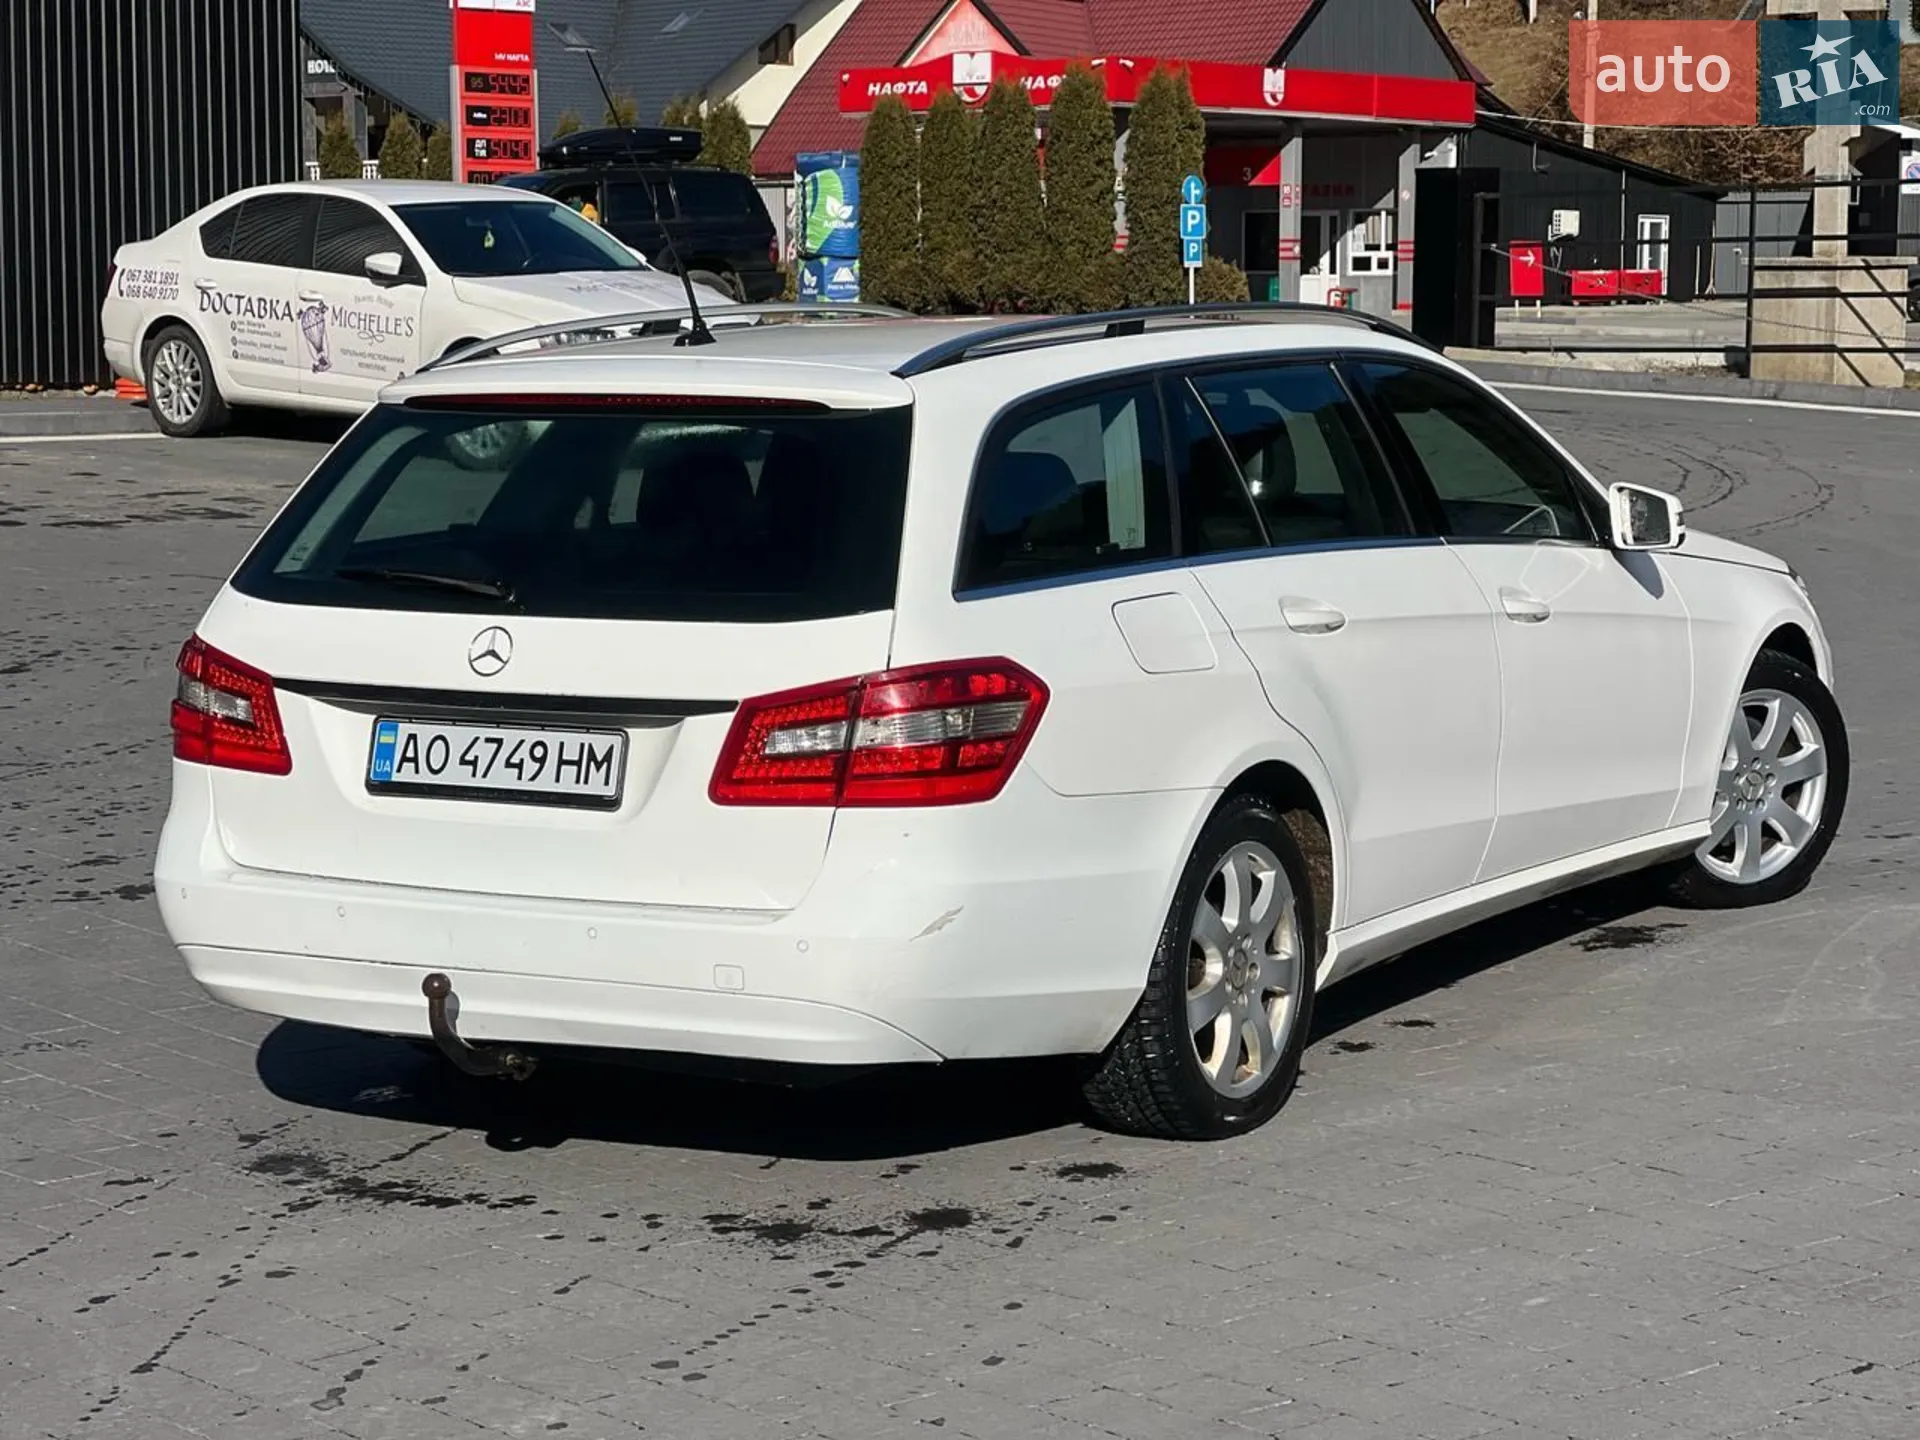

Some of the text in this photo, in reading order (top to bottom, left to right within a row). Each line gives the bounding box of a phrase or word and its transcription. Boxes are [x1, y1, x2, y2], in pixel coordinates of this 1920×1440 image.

[867, 80, 929, 97] НАФТА
[1020, 73, 1066, 91] НАФ
[1187, 209, 1201, 233] P
[1188, 242, 1199, 259] P
[142, 269, 158, 284] 381
[158, 270, 180, 286] 1891
[142, 285, 158, 300] 640
[157, 287, 180, 301] 9170
[375, 762, 391, 773] UA
[458, 736, 549, 783] 4749
